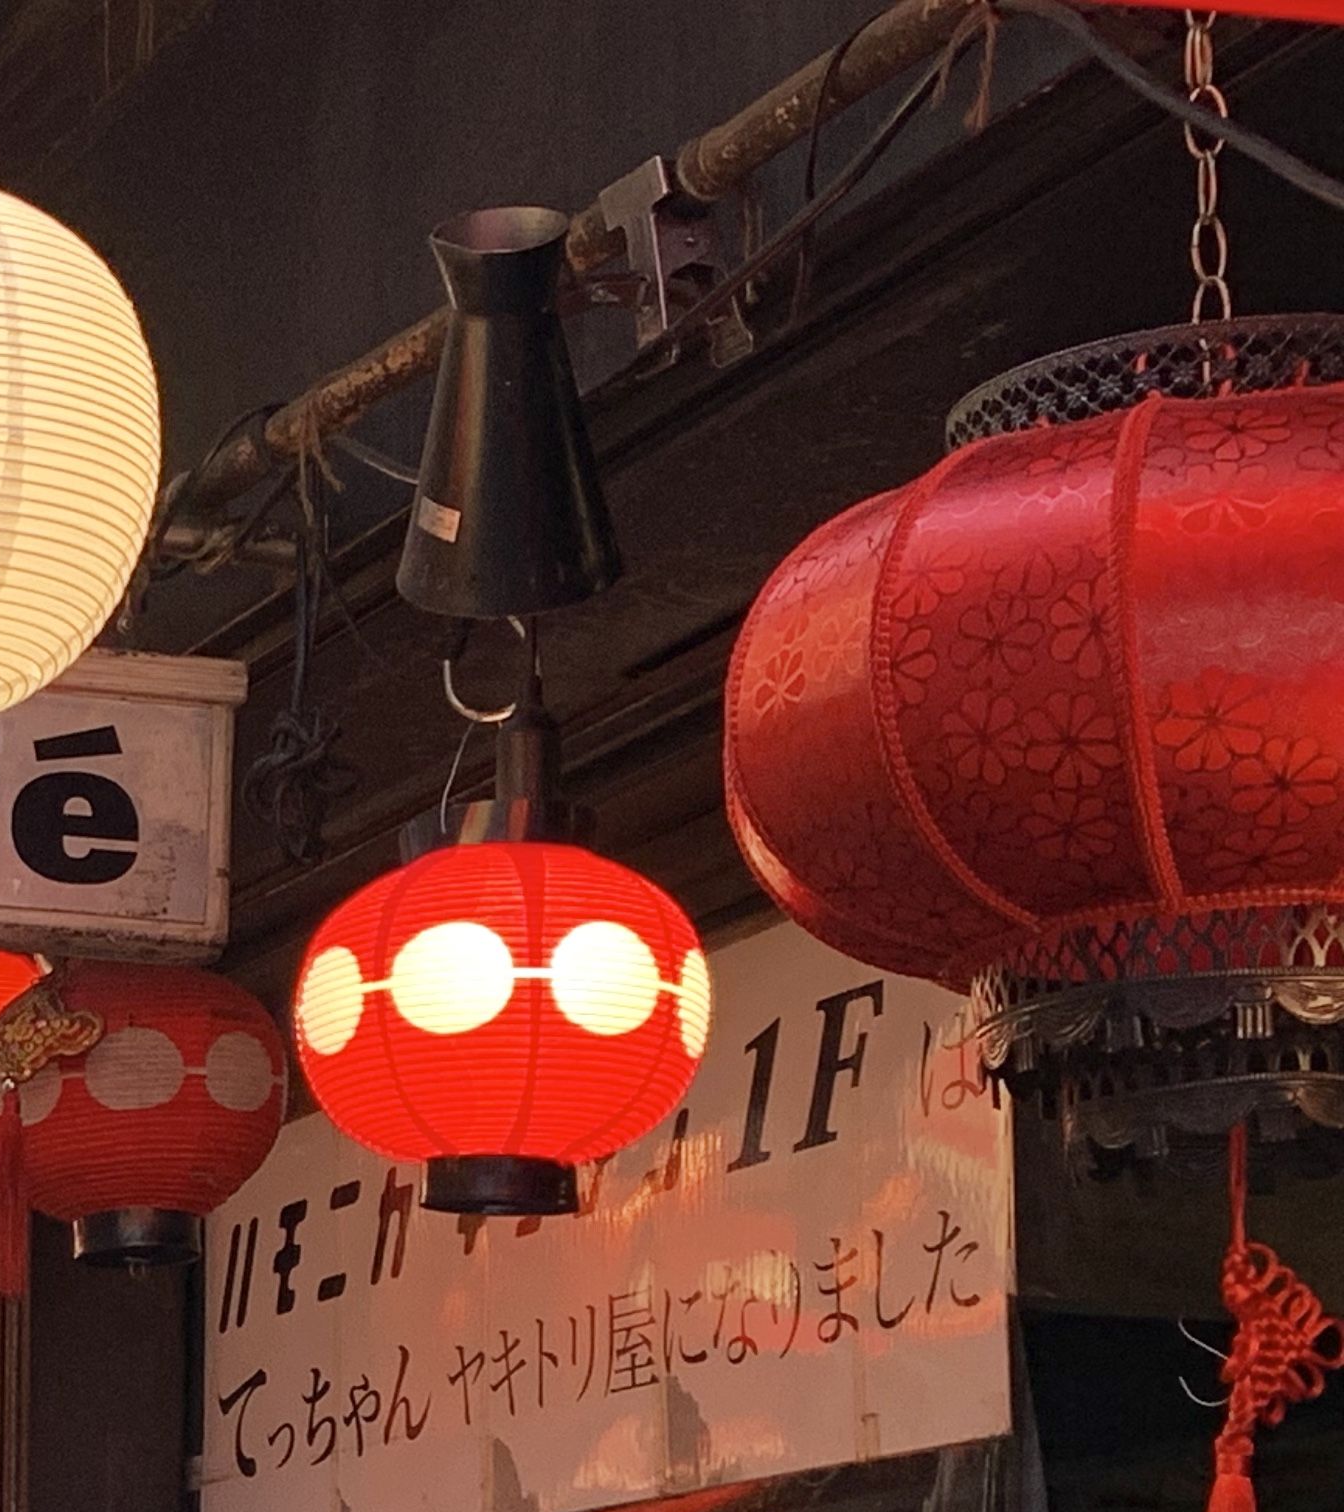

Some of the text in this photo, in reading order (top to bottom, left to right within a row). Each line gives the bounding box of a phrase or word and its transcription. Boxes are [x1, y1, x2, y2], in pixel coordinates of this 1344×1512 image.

[726, 979, 885, 1174] 1F
[219, 1209, 982, 1479] てっちゃん ヤキトリ屋になりました
